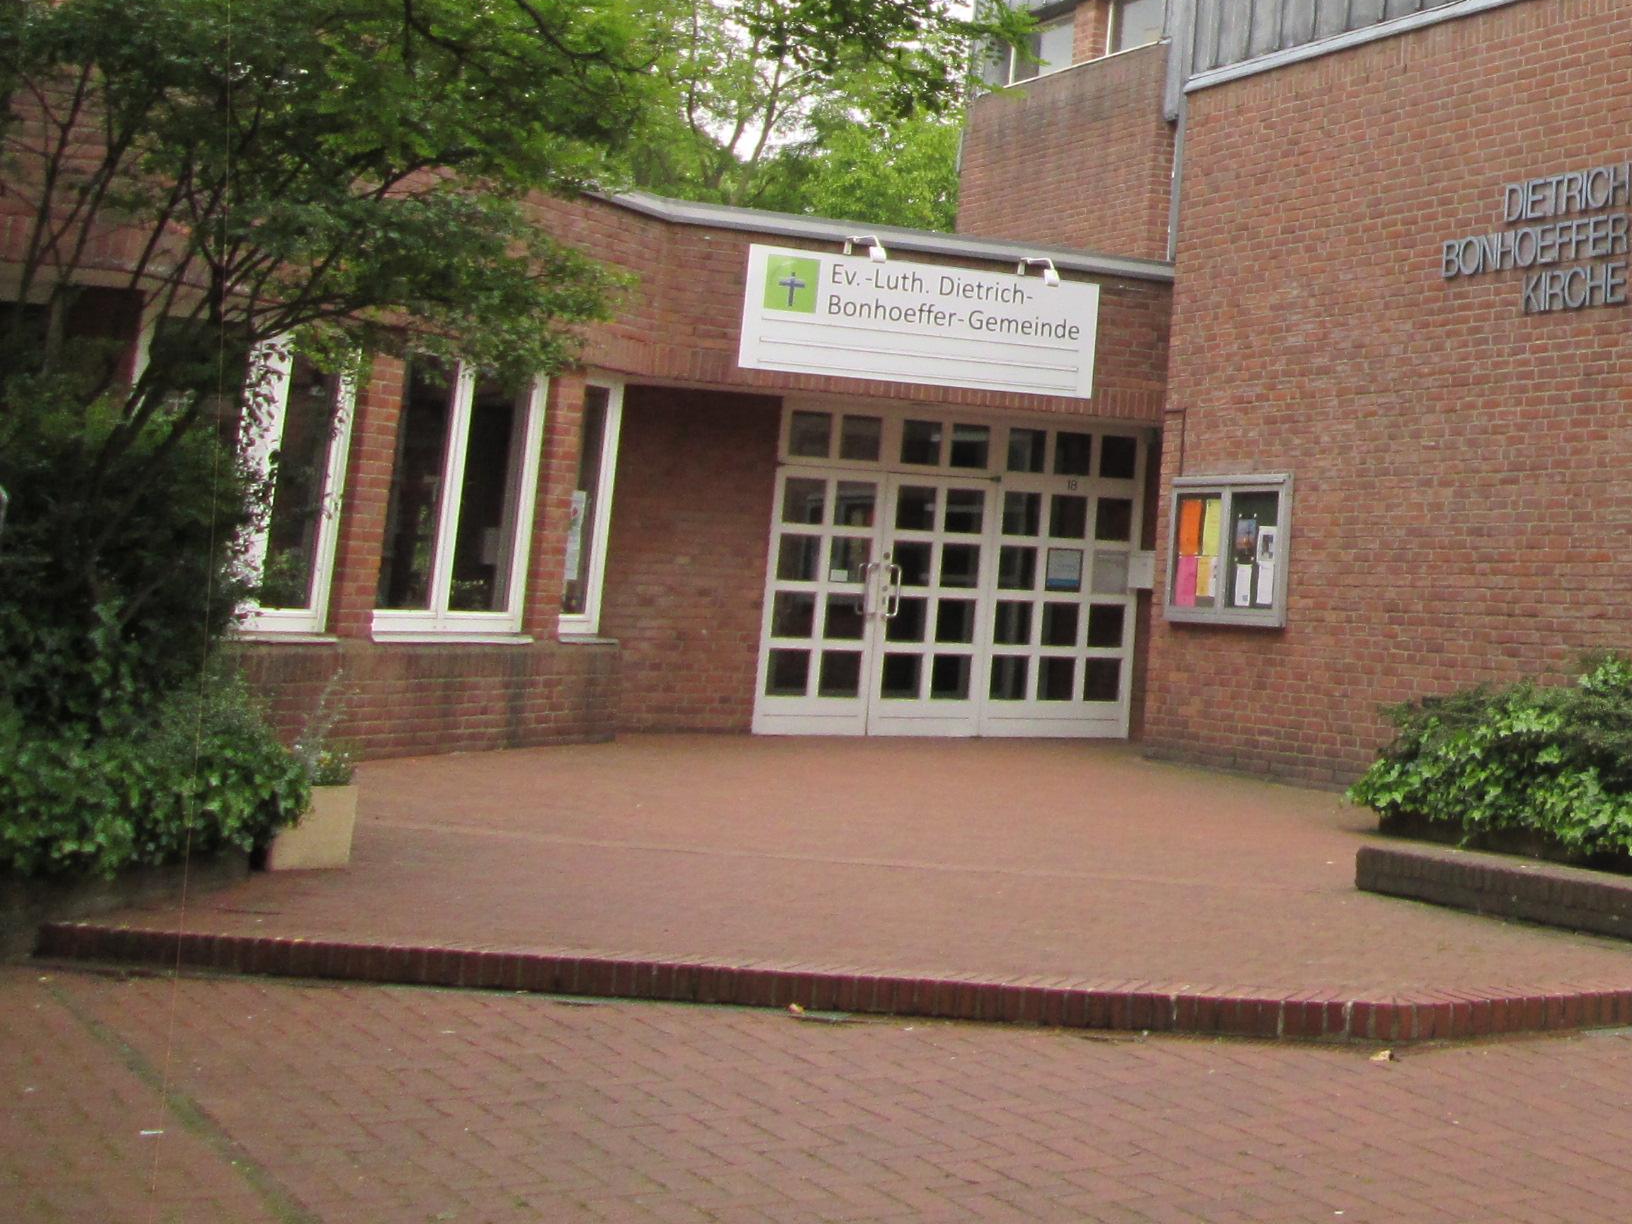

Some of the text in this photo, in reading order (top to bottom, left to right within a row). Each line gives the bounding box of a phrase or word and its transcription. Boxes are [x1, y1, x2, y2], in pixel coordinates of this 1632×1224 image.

[1504, 162, 1632, 223] DIETRICH
[1441, 213, 1629, 279] BONHOEFFER
[831, 263, 1033, 305] Ev.-Luth. Dietrich-
[1524, 261, 1627, 313] KIRCHE
[827, 294, 1081, 341] Bonhoeffer-Gemeinde
[1066, 479, 1078, 491] 18
